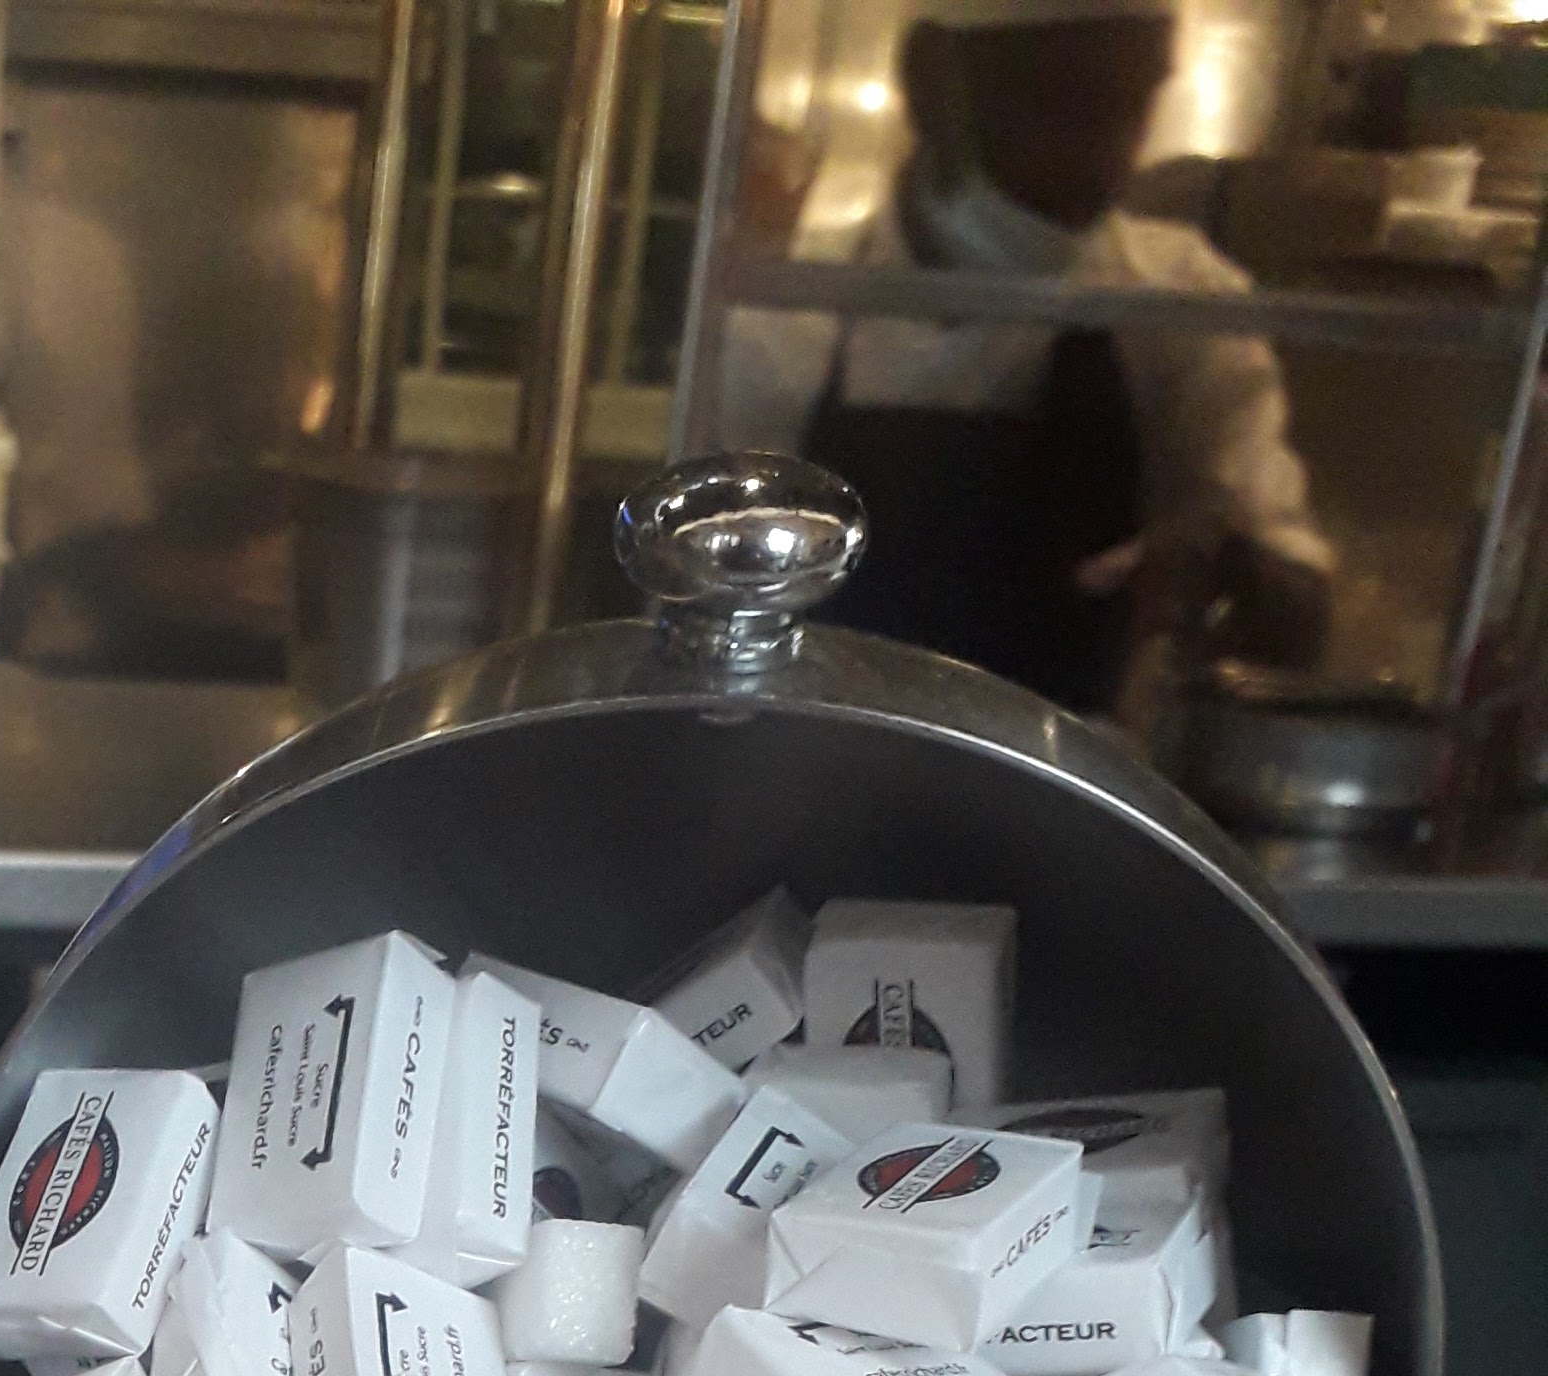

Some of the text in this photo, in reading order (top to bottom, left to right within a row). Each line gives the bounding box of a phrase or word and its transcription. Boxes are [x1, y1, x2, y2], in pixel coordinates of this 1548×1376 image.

[62, 1095, 103, 1160] CAFÉS
[394, 1030, 423, 1140] CAFÉS
[492, 1015, 518, 1219] TORRÉFACTEUR
[20, 1168, 73, 1272] RICHARD
[998, 1322, 1117, 1345] ACTEUR
